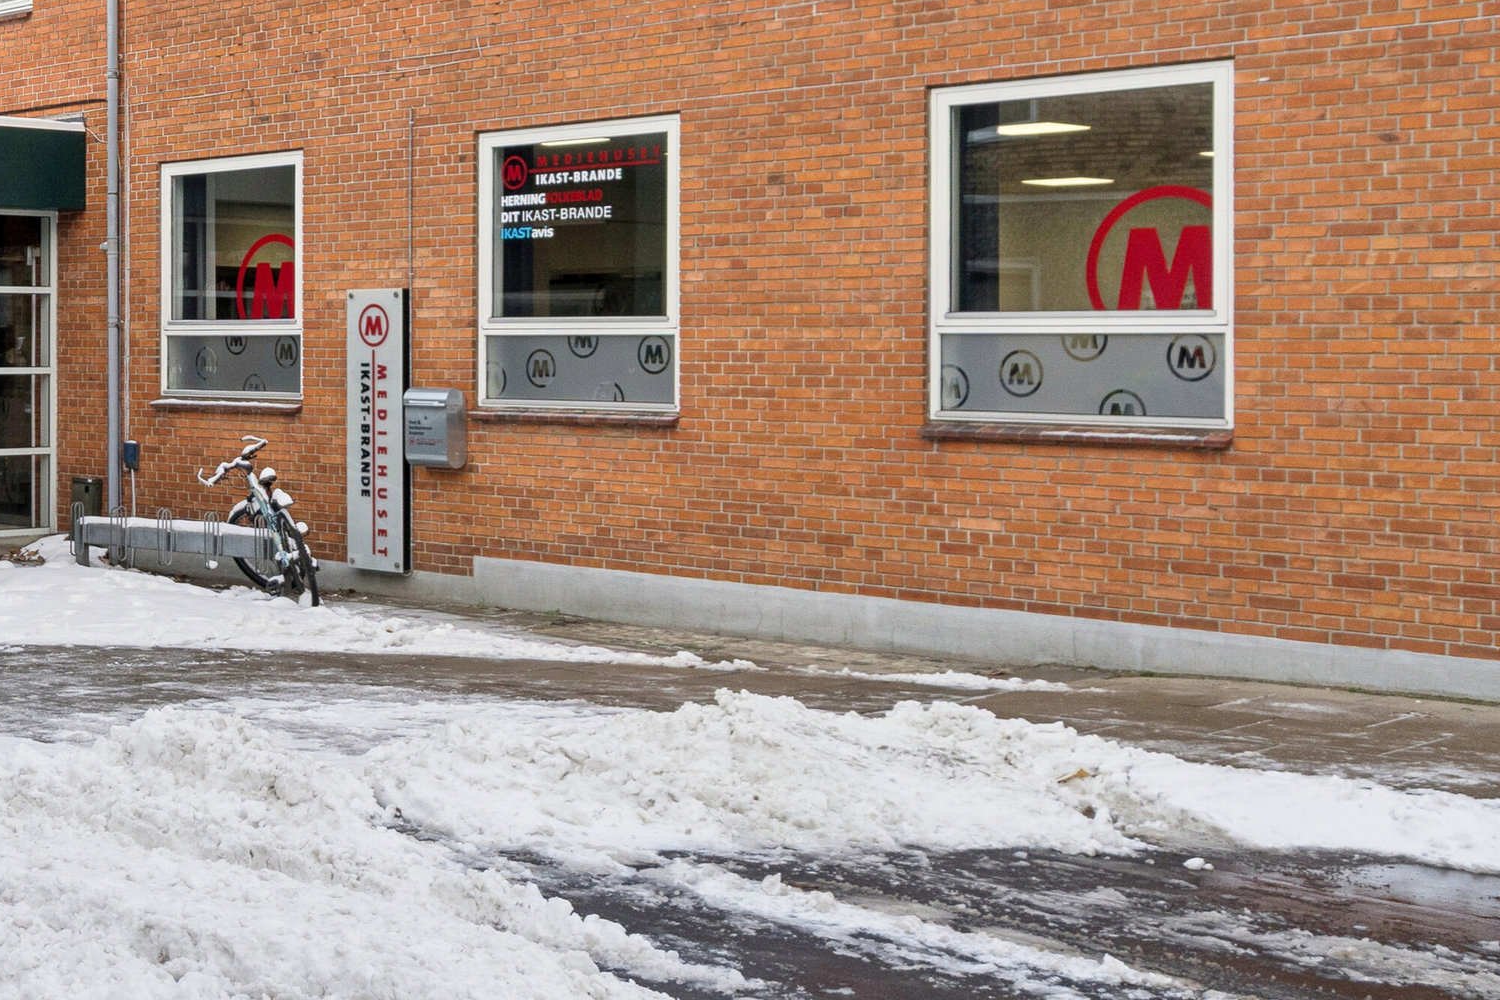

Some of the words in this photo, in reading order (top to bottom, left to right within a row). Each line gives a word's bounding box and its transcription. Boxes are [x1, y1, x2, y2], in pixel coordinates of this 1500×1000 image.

[537, 146, 660, 166] MEDIEHUSET
[507, 165, 521, 181] M
[535, 168, 623, 186] IKAST-BRANDE
[501, 211, 520, 223] DIT
[522, 205, 612, 222] IKAST-BRANDE
[1117, 225, 1213, 310] M
[365, 315, 383, 336] M
[644, 345, 664, 364] M
[1177, 345, 1207, 368] M
[360, 362, 371, 497] IKAST-BRANDE
[377, 364, 388, 557] MEDIEHUSET
